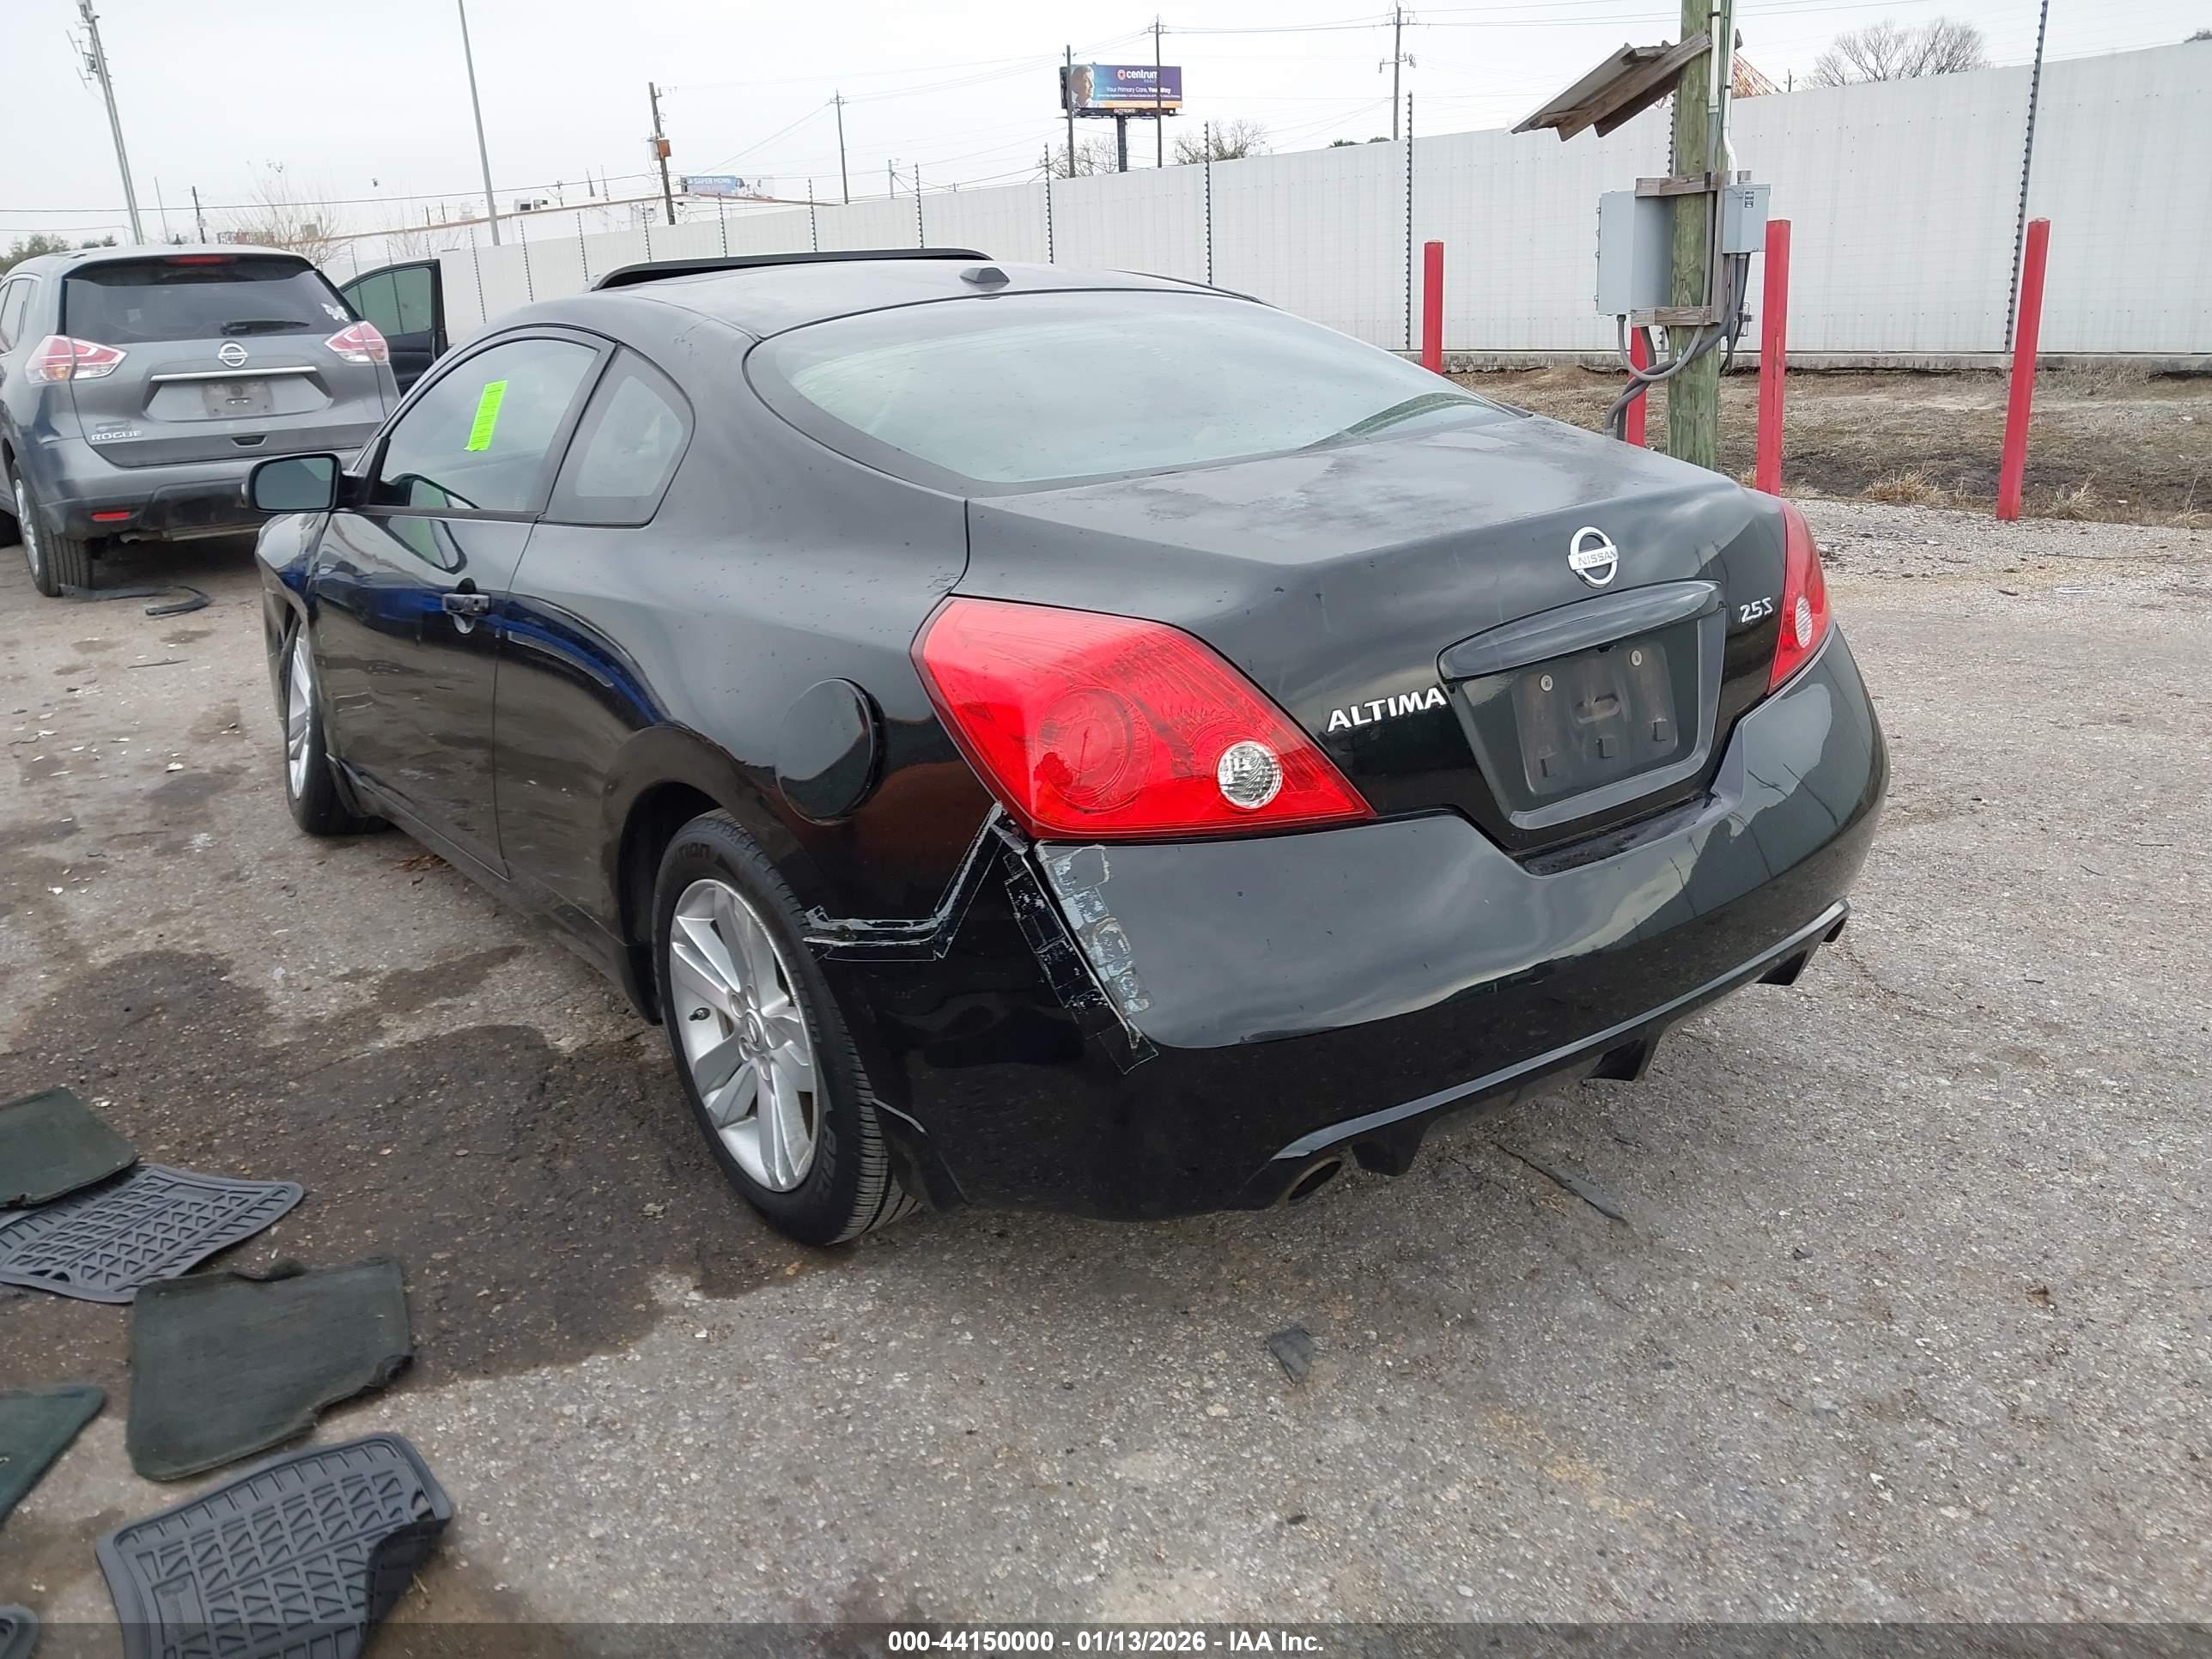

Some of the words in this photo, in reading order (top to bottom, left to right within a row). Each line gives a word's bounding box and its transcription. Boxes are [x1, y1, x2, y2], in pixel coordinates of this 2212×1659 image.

[91, 430, 143, 441] ROGUE
[1578, 550, 1617, 566] NISSAN
[1327, 687, 1448, 732] ALTIMA
